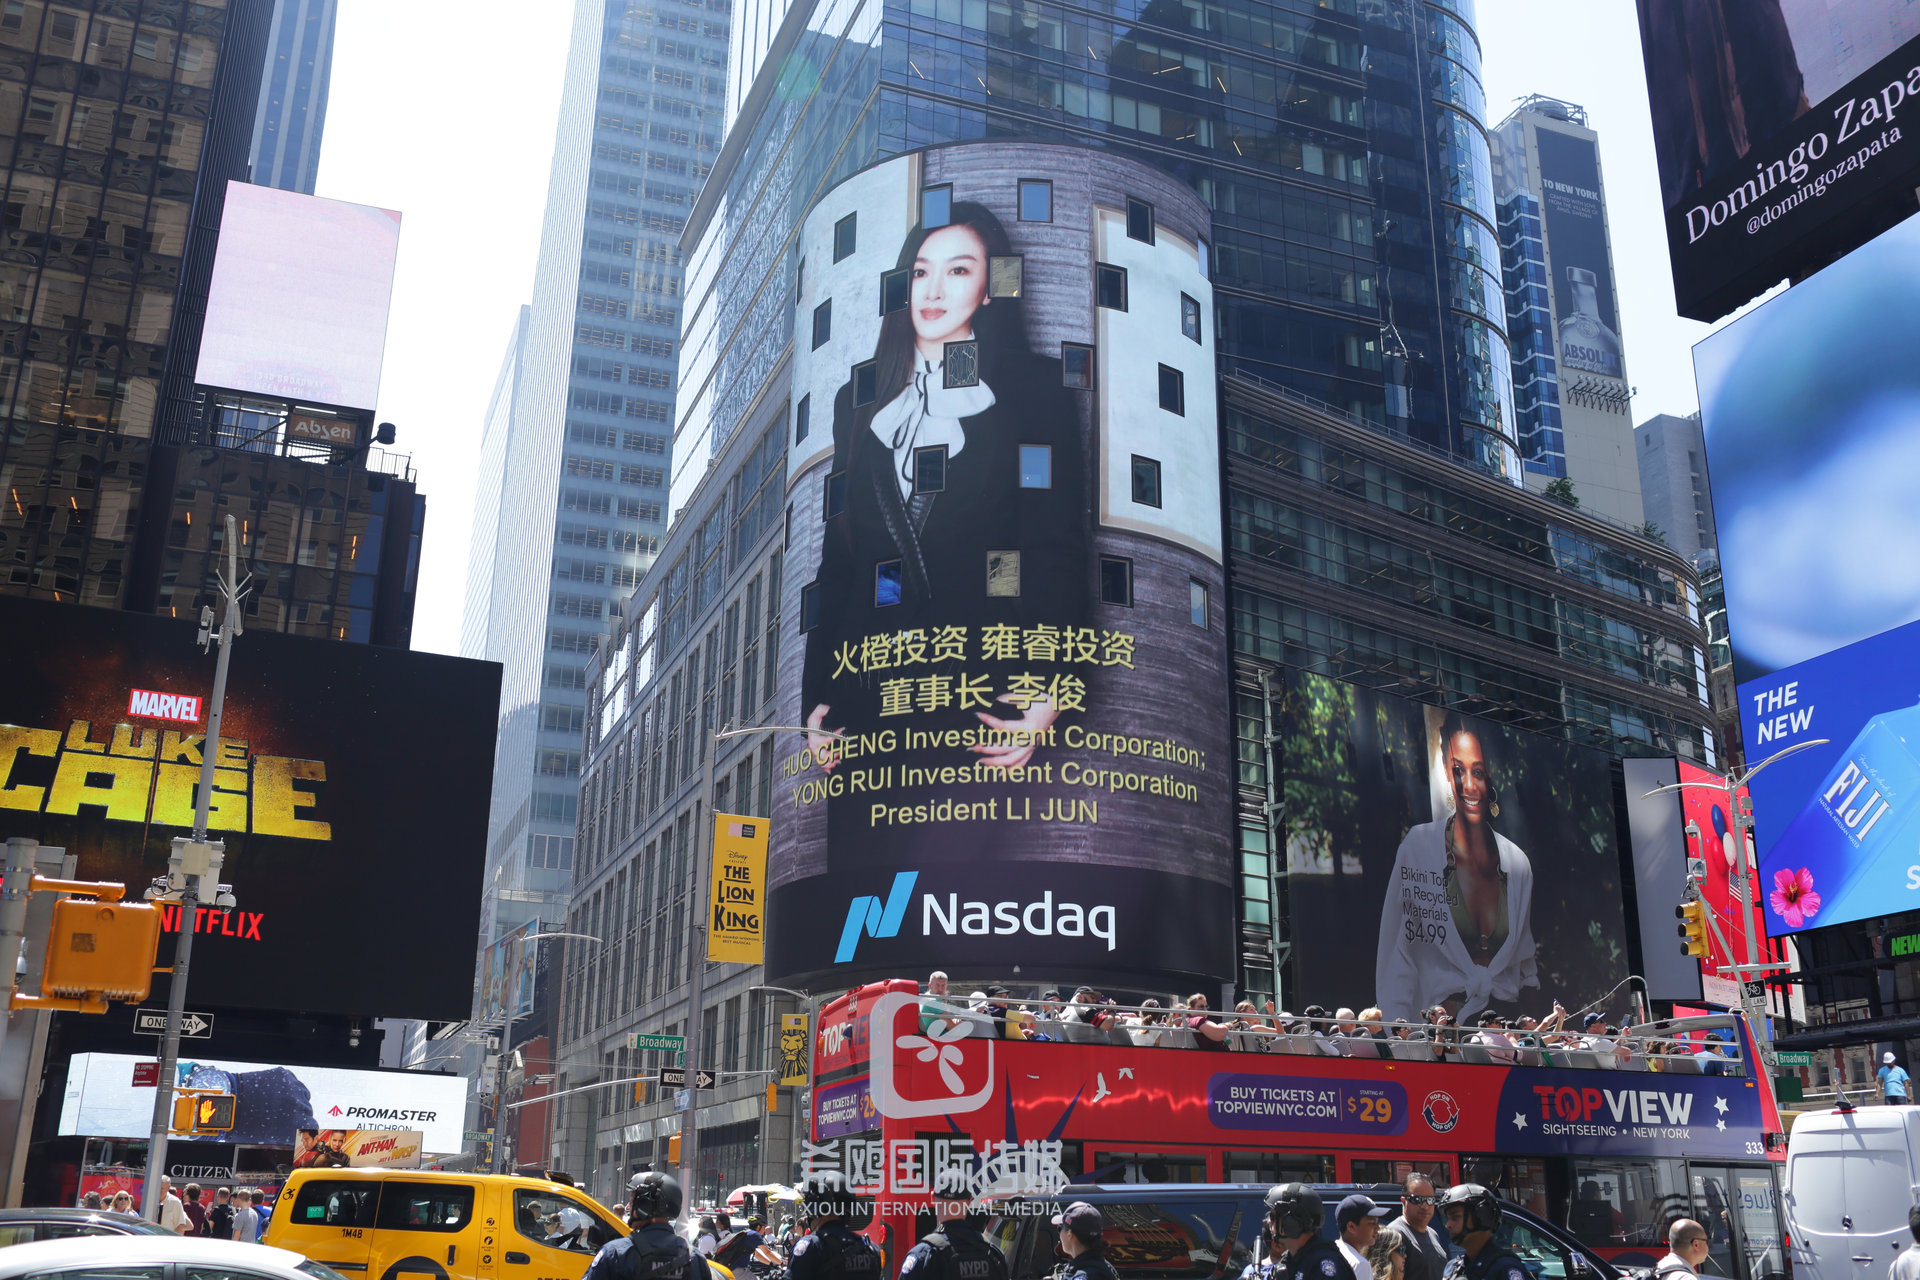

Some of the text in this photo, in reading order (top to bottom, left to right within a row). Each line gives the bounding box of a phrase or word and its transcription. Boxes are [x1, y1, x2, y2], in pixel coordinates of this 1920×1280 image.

[1685, 65, 1920, 244] Domingo Zapa
[1542, 178, 1554, 189] TO
[1554, 182, 1574, 194] NEW
[1746, 127, 1902, 234] @domingozapata
[1564, 343, 1616, 366] ABSOLUT
[294, 420, 351, 440] Absen
[832, 623, 1136, 679] 火橙投资 雍睿投资
[879, 672, 1087, 717] 董事长 李俊
[1754, 680, 1798, 716] THE
[130, 690, 199, 722] MARVEL
[1757, 705, 1815, 745] NEW
[64, 718, 249, 770] LUKE
[782, 724, 1206, 780] HUO CHENG Investment Corporation;
[0, 724, 332, 841] CAGE
[792, 762, 1198, 808] YONG RUI Investment Corporation
[870, 798, 1098, 826] President LI JUN
[1823, 760, 1890, 842] FIJI
[1818, 798, 1834, 818] NATURAL
[1848, 834, 1860, 849] WATER
[728, 850, 748, 862] Disney
[724, 865, 750, 880] THE
[1401, 866, 1448, 890] Bikini Top
[718, 880, 754, 904] LION
[1402, 884, 1458, 906] in Recycled
[714, 904, 759, 931] KING
[923, 890, 1116, 951] Nasdaq
[1403, 902, 1448, 922] Materials
[1405, 918, 1446, 945] $4.99
[1754, 996, 1766, 1004] LANE
[146, 1018, 166, 1027] ONE
[640, 1036, 682, 1051] Broadway
[1780, 1052, 1810, 1064] Broadway
[668, 1074, 684, 1082] ONE
[823, 1094, 857, 1112] BUY TICKETS AT
[1230, 1086, 1336, 1103] BUY TICKETS AT
[1532, 1084, 1693, 1126] TOPVIEW
[346, 1106, 436, 1122] PROMASTER
[1214, 1100, 1337, 1118] TOPVIEWNYC.COM
[1432, 1120, 1454, 1130] HOP OFF
[1542, 1124, 1690, 1140] SIGHTSEEING NEW YORK
[357, 1136, 398, 1156] ANT-MAN
[1745, 1142, 1764, 1155] 333
[170, 1164, 234, 1180] CITIZEN
[959, 1260, 990, 1276] NYPD
